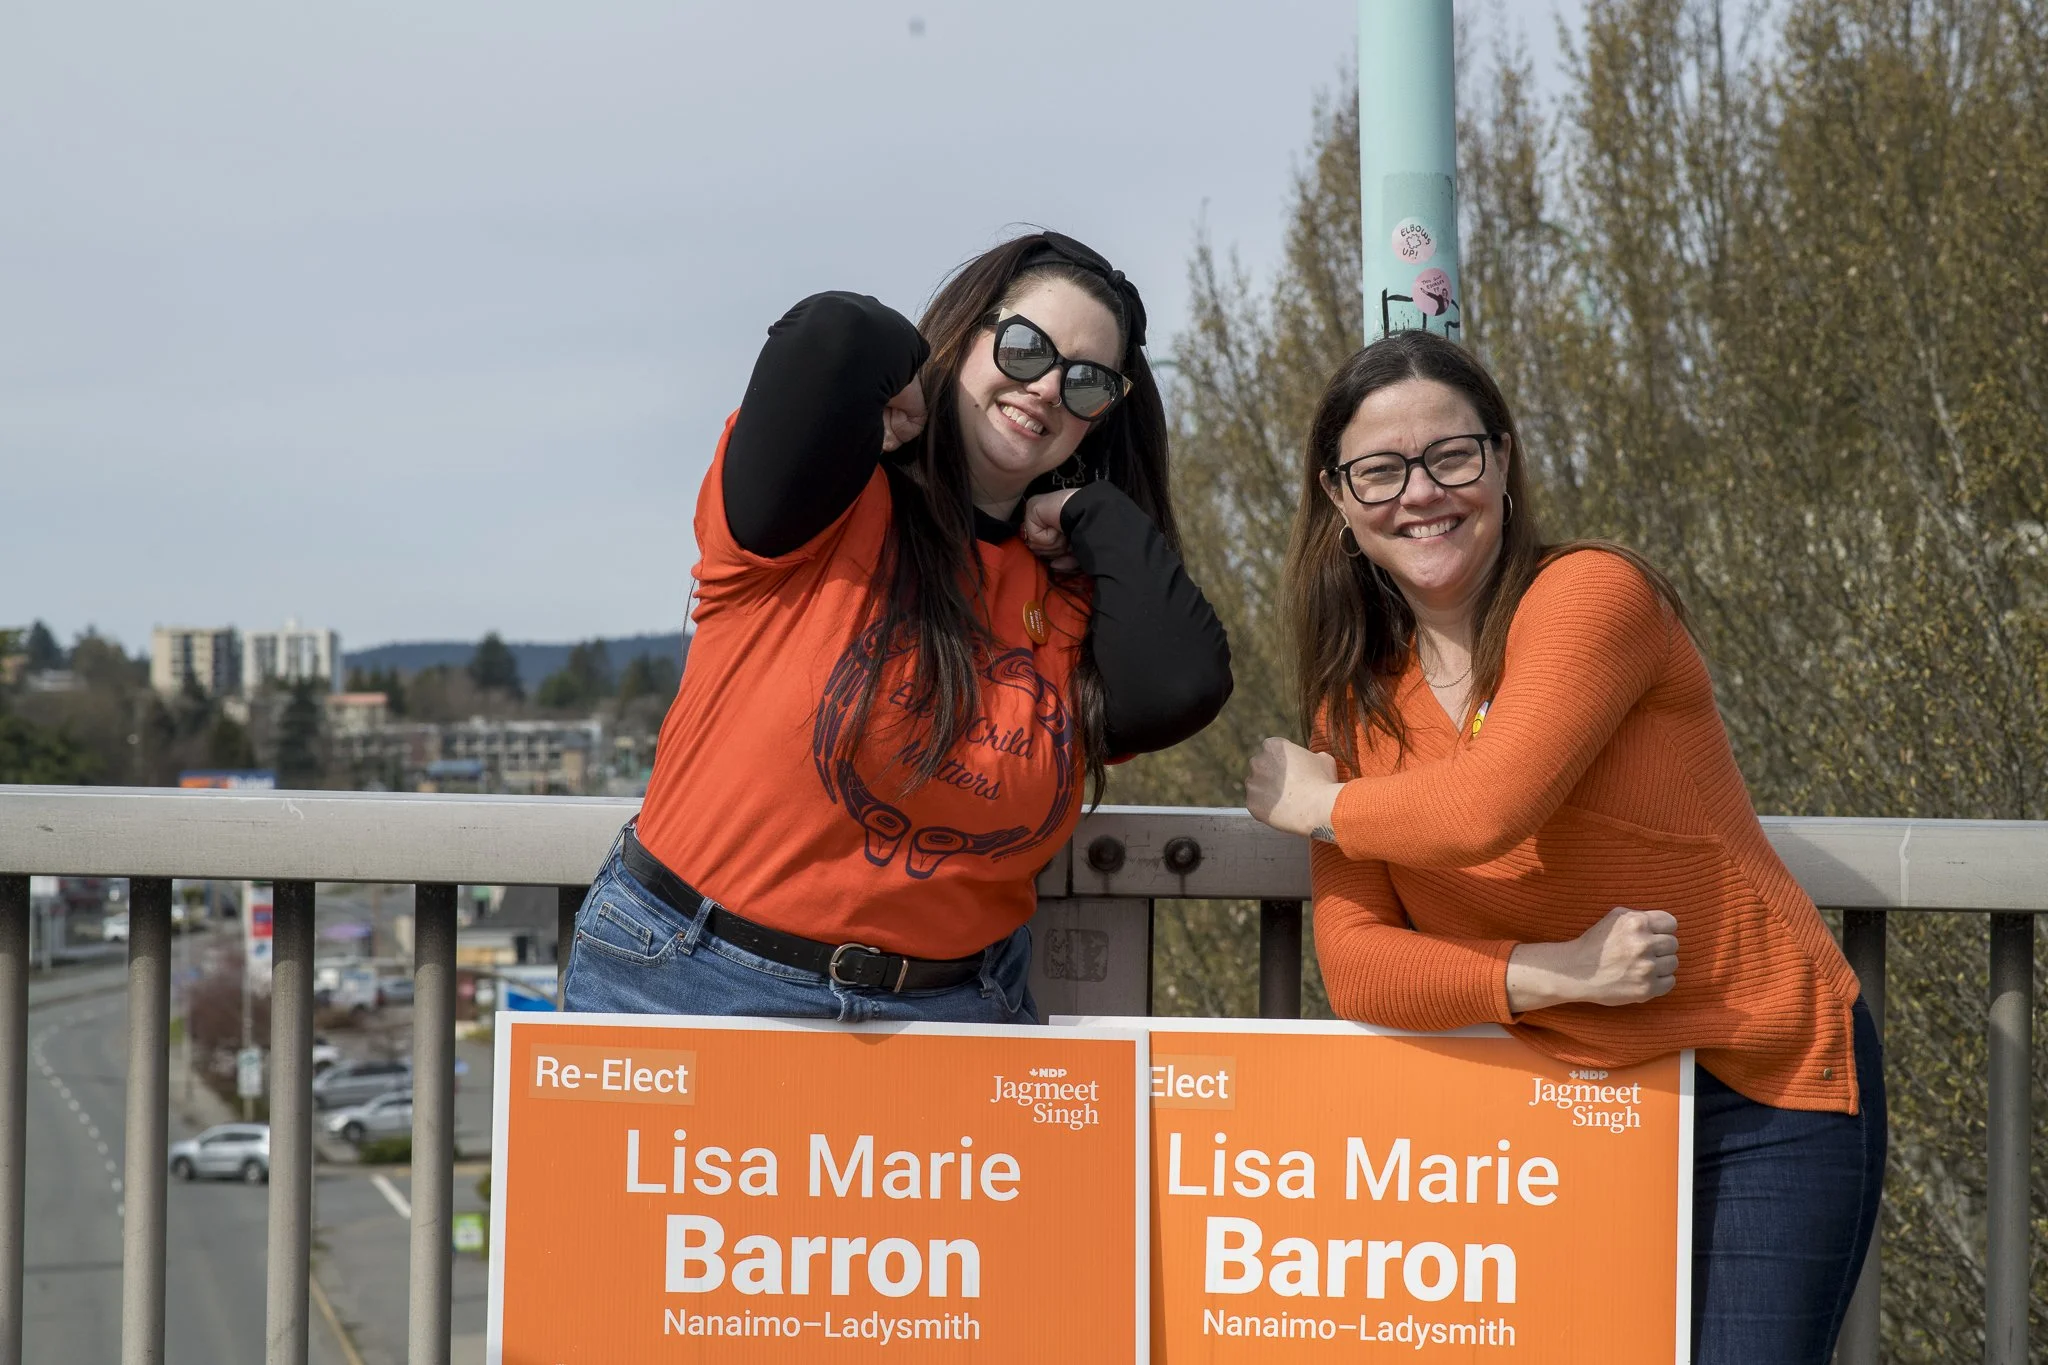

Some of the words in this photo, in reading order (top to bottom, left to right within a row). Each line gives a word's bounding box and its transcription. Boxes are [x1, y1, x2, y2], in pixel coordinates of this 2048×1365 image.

[1400, 223, 1431, 245] ELBOWS
[1402, 247, 1418, 260] UP!
[965, 716, 1034, 760] Child
[898, 738, 1001, 801] Mtters
[536, 1056, 689, 1096] Re-Elect
[1038, 1068, 1067, 1078] NDP
[1579, 1070, 1609, 1080] NDP
[990, 1075, 1099, 1107] Jagmeet
[1528, 1077, 1642, 1109] Jagmeet
[1033, 1102, 1099, 1131] Singh
[1572, 1105, 1642, 1134] Singh
[626, 1129, 779, 1197] Lisa
[809, 1133, 1021, 1202] Marie
[1168, 1132, 1316, 1199] Lisa
[1345, 1136, 1559, 1207] Marie
[665, 1214, 981, 1298] Barron
[1204, 1215, 1517, 1304] Barron
